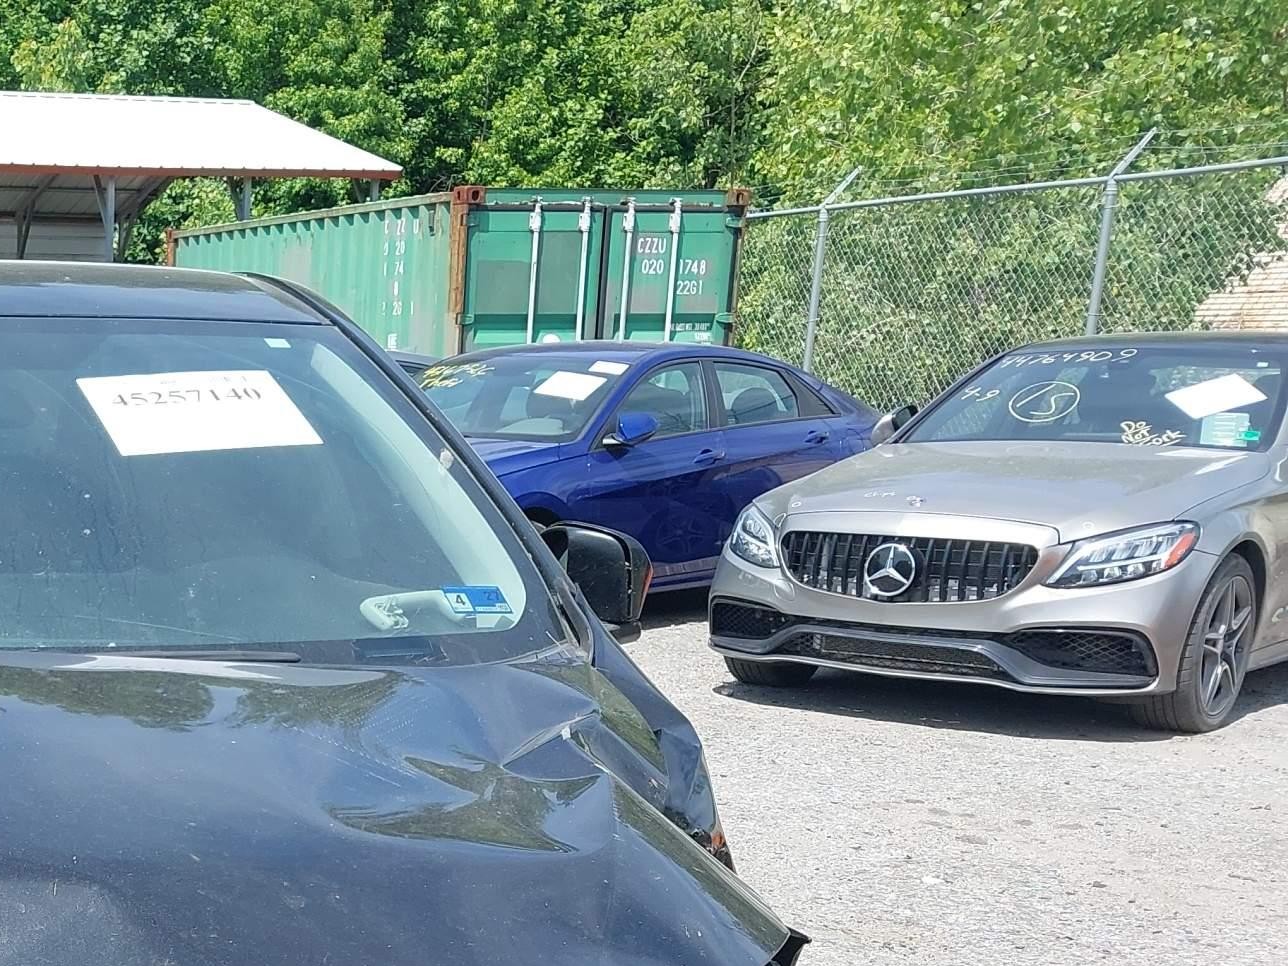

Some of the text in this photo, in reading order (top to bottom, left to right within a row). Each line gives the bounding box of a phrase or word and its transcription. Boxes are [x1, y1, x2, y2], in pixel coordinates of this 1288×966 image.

[637, 237, 667, 254] CZZU
[641, 259, 706, 275] 020 1748
[676, 280, 703, 295] 22G1
[112, 387, 262, 406] 45257140
[1120, 420, 1151, 434] Do
[455, 594, 466, 605] 4
